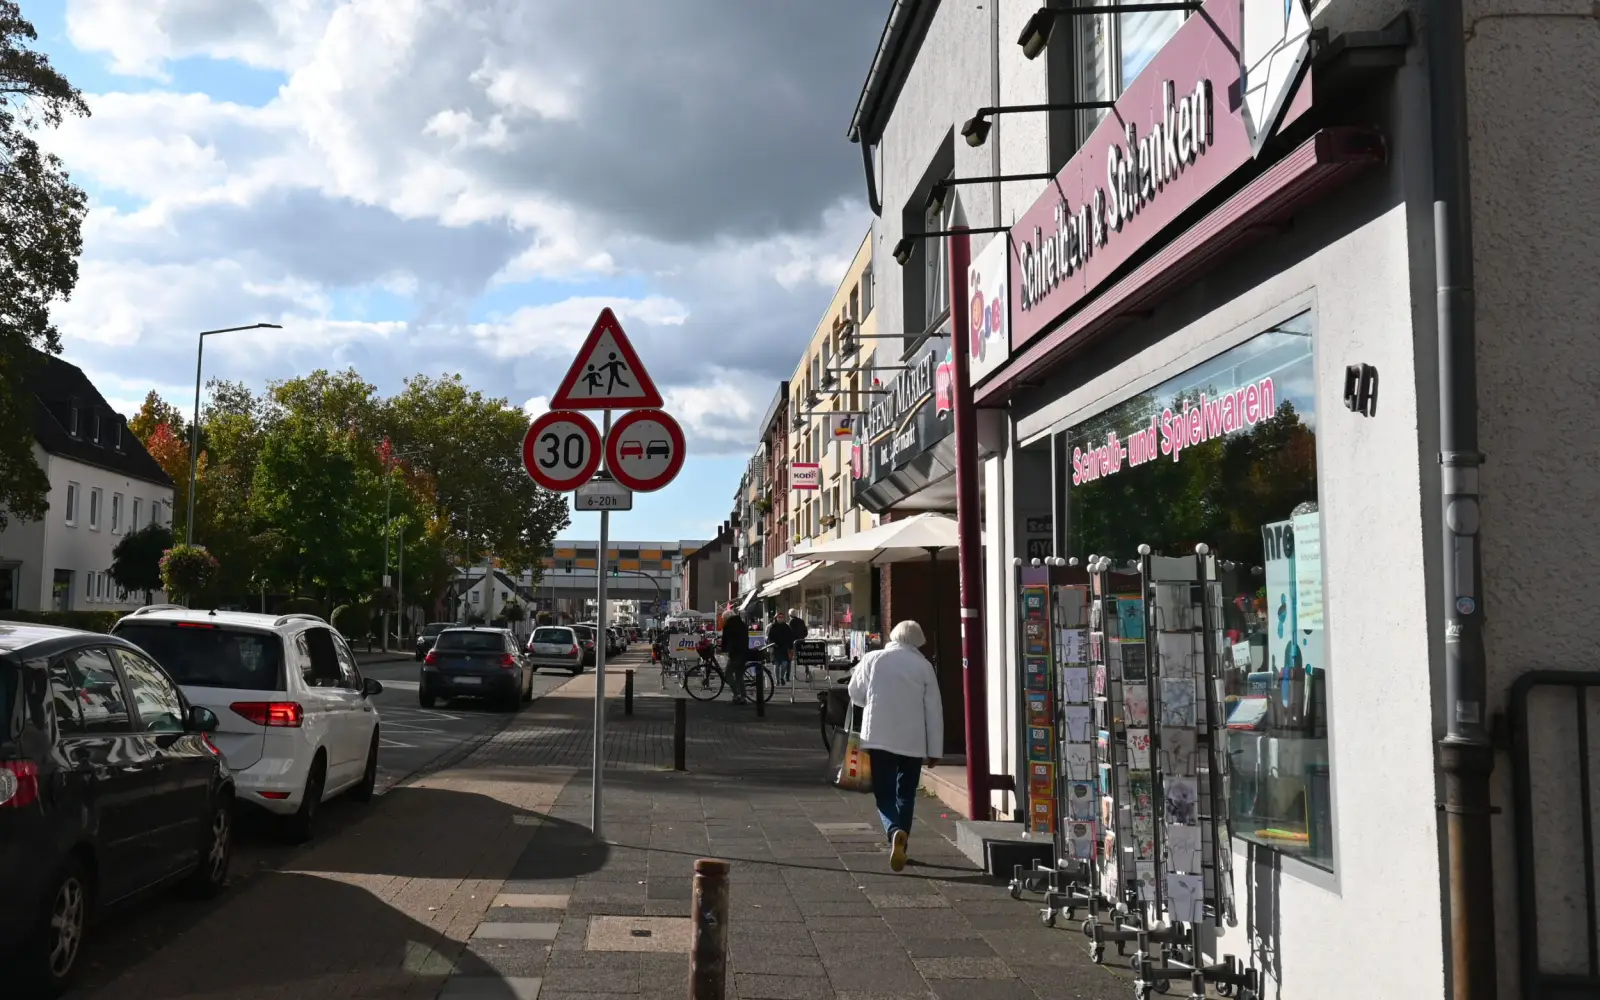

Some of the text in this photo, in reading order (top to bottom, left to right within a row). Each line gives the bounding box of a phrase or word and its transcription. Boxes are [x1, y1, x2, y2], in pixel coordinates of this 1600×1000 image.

[1020, 80, 1210, 309] Schreiben & Schenken
[539, 433, 584, 469] 30
[1072, 376, 1275, 486] Schreib- und Spielwaren
[679, 637, 694, 647] dm
